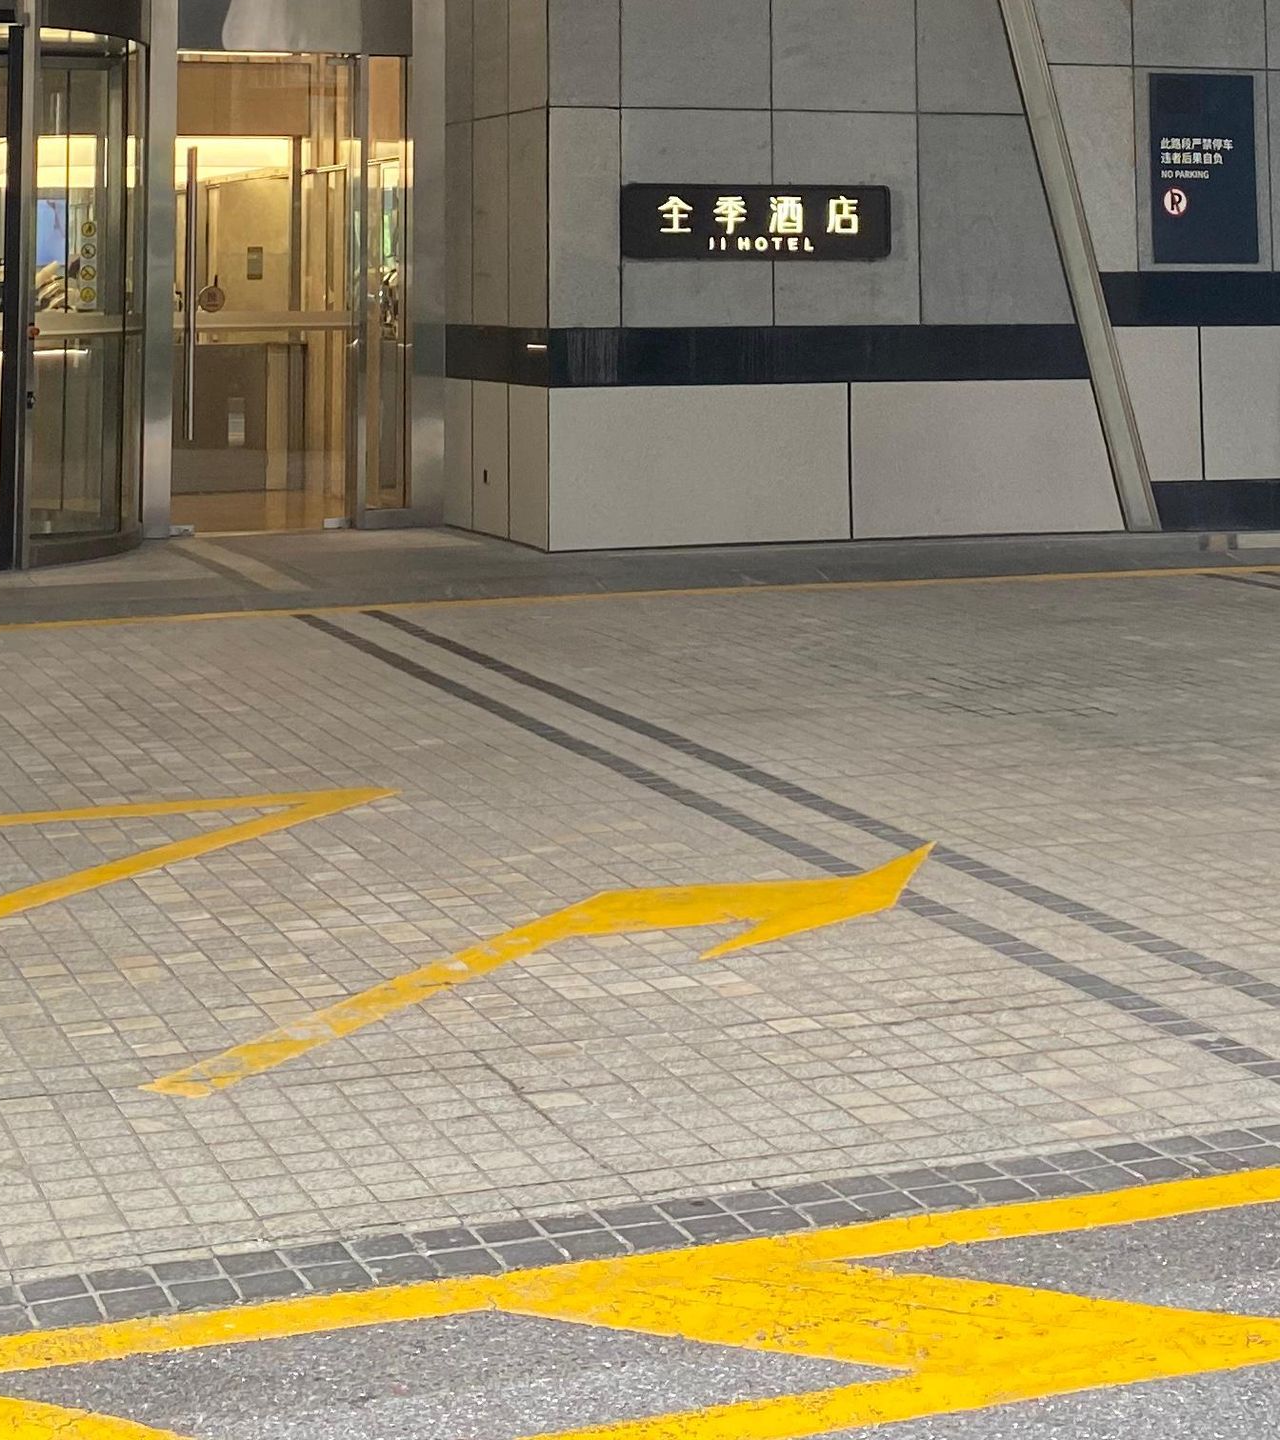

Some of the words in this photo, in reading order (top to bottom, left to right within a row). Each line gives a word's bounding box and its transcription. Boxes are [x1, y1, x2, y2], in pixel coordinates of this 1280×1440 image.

[1160, 137, 1233, 150] 此路段严禁停车
[1160, 152, 1223, 164] 违者后果自负
[1161, 170, 1174, 178] NO
[1175, 170, 1209, 179] PARKING
[657, 195, 860, 235] 全季酒店
[737, 236, 815, 252] HOTEL
